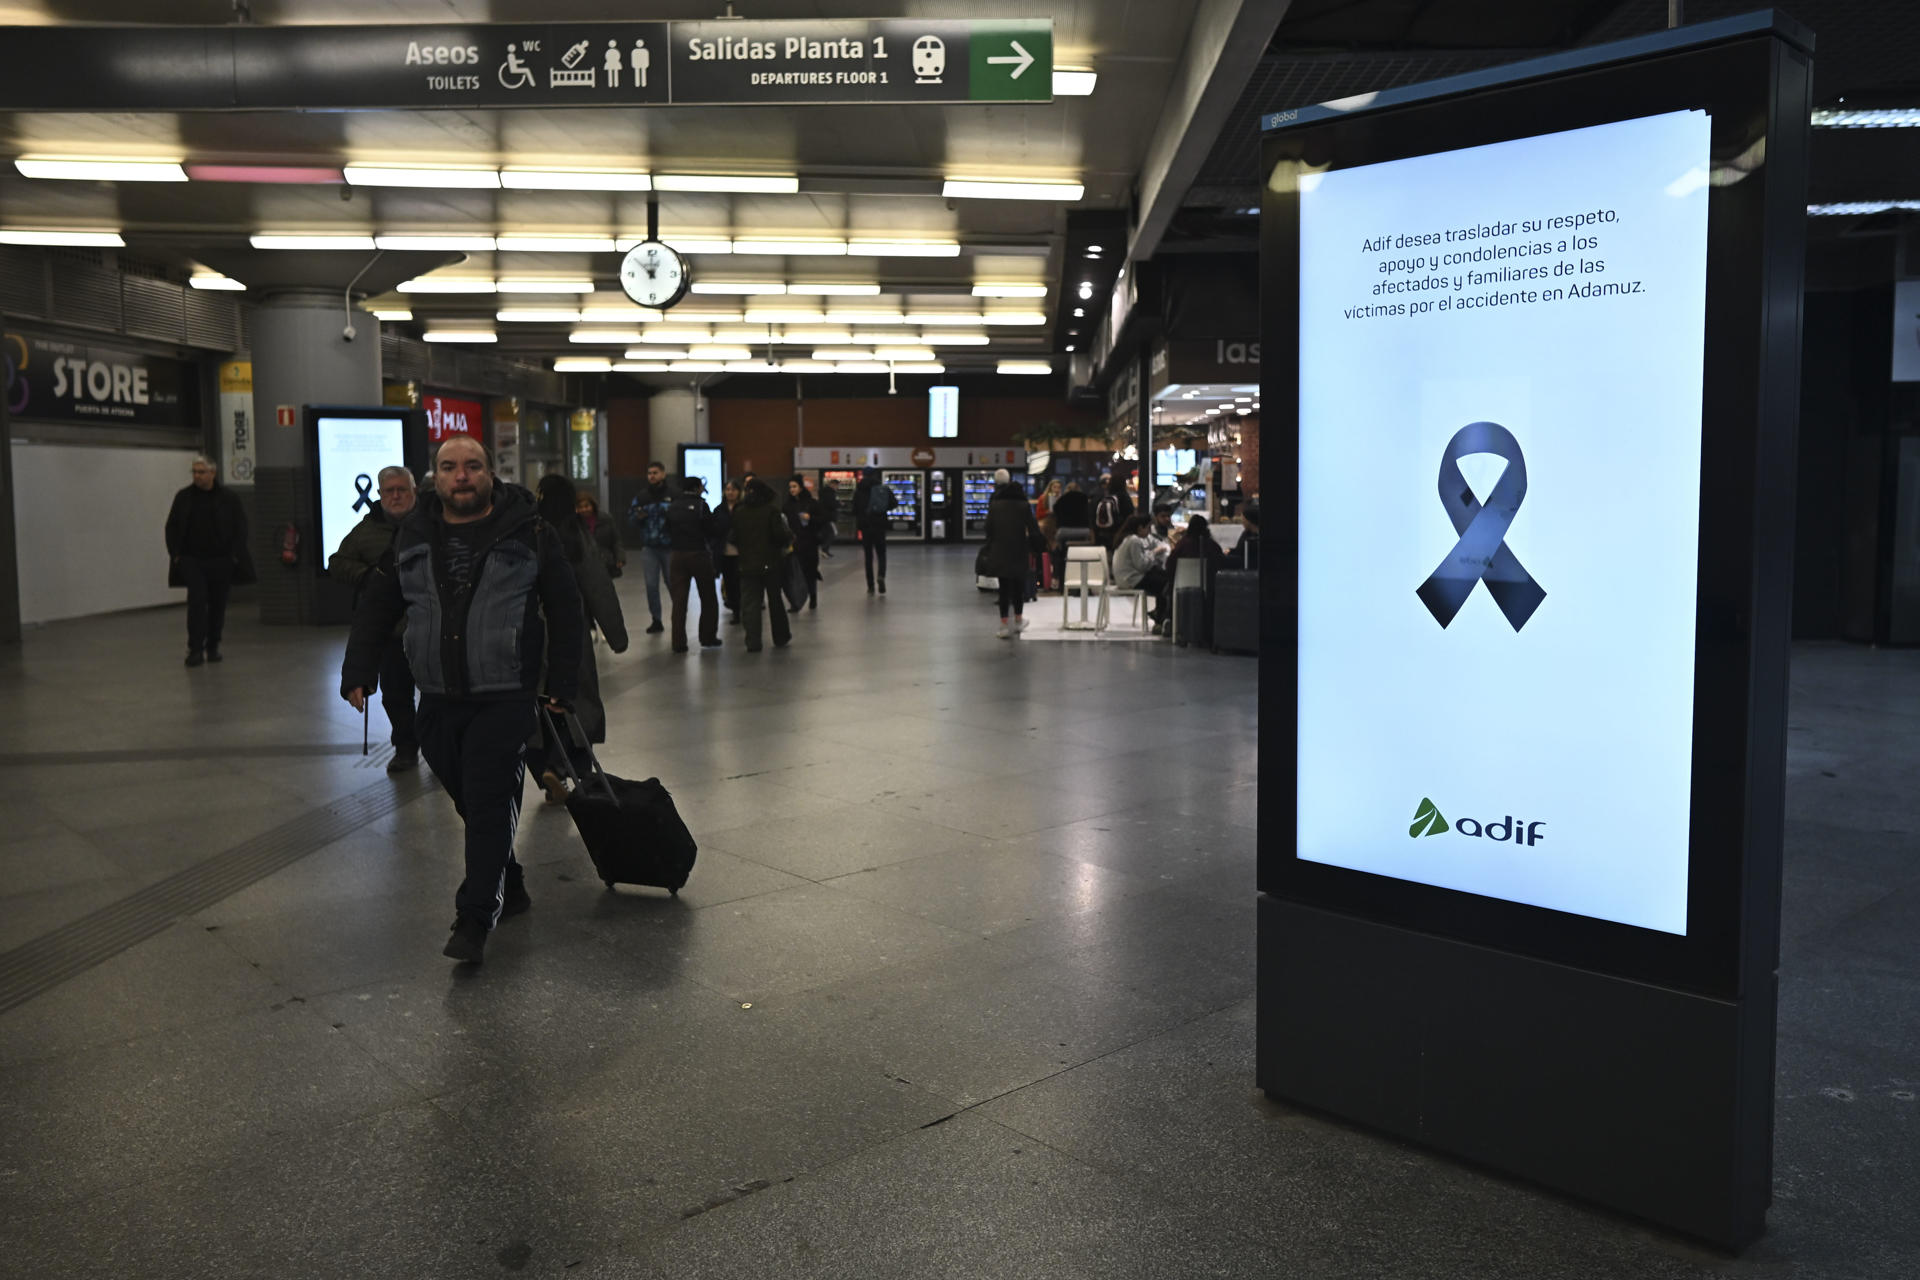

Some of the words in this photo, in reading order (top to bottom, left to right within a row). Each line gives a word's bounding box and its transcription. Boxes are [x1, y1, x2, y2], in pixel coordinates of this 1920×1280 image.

[405, 41, 479, 65] Aseos
[522, 40, 541, 52] WC
[688, 36, 777, 60] Salidas
[785, 36, 863, 60] Planta
[872, 36, 888, 59] 1
[426, 75, 480, 90] TOILETS
[751, 72, 833, 85] DEPARTURES
[836, 72, 877, 84] FLOOR
[880, 72, 888, 84] 1
[1271, 109, 1298, 128] global
[1362, 235, 1392, 253] Adif
[1395, 233, 1441, 249] desea
[1445, 221, 1518, 242] trasladar
[1522, 220, 1542, 233] su
[1547, 209, 1620, 230] respeto,
[1379, 257, 1425, 275] apoyo
[1430, 256, 1439, 271] y
[1443, 241, 1552, 266] condolencias
[1557, 240, 1567, 252] a
[1572, 235, 1598, 250] los
[1372, 275, 1449, 295] afectados
[1453, 275, 1463, 291] y
[1468, 266, 1548, 285] familiares
[1553, 260, 1575, 277] de
[1580, 258, 1605, 274] las
[1344, 303, 1406, 319] víctimas
[1410, 301, 1435, 317] por
[1439, 295, 1452, 311] el
[1456, 290, 1537, 309] accidente
[1542, 288, 1563, 301] en
[1568, 281, 1646, 299] Adamuz.
[53, 357, 150, 406] STORE
[234, 409, 247, 450] STORE
[1455, 815, 1547, 847] adif
